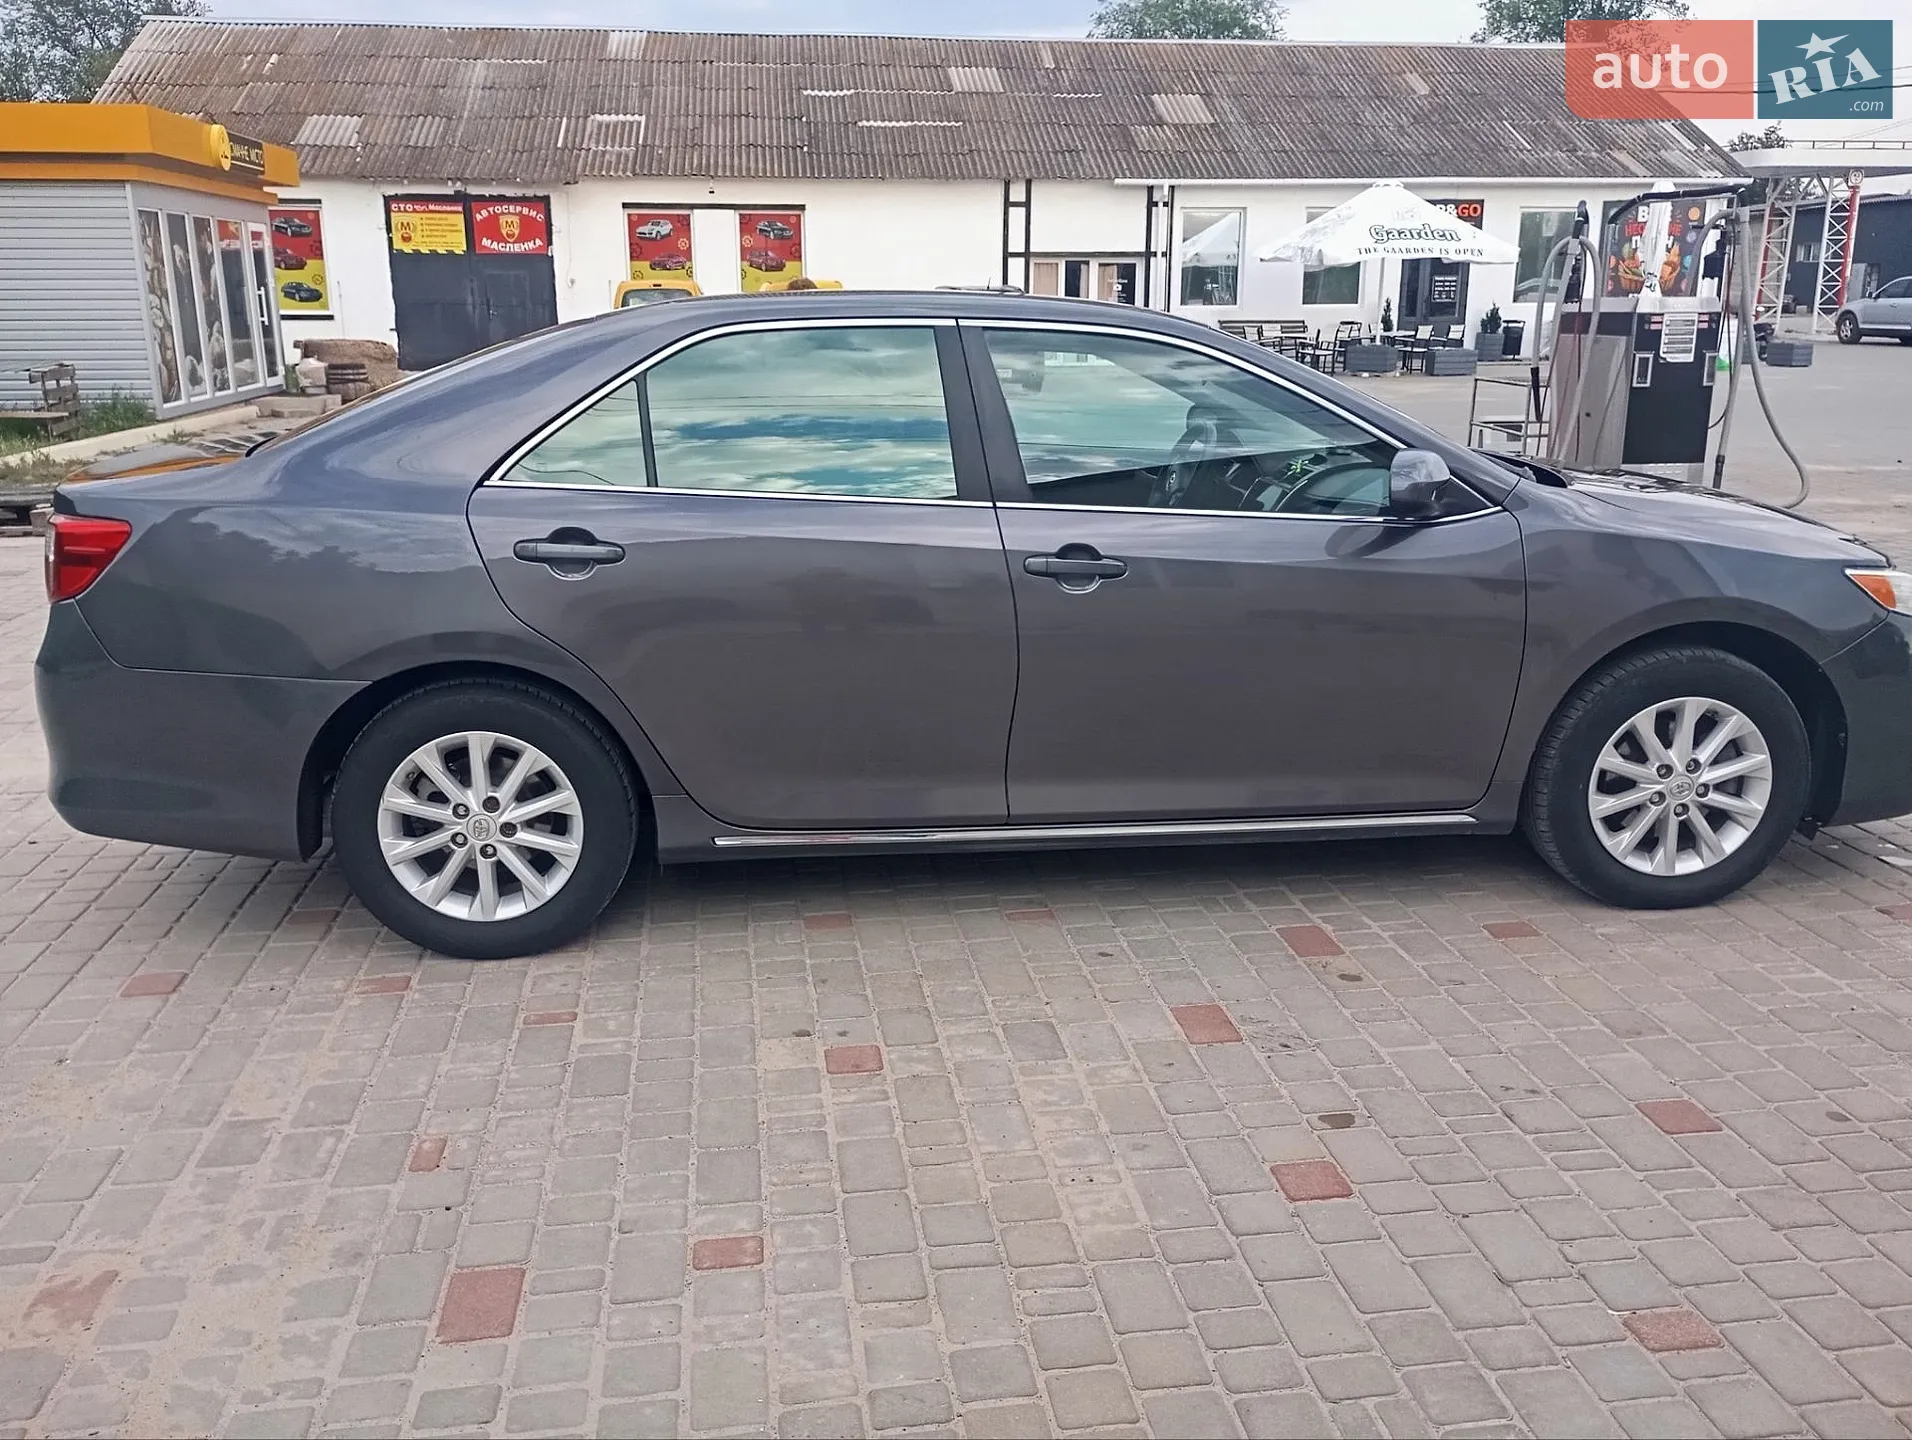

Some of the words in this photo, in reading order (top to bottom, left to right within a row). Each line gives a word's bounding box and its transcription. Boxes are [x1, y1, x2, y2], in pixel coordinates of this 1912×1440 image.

[391, 203, 413, 211] СТО
[475, 204, 545, 222] АВТОСЕРВИС
[1369, 223, 1461, 244] Gaarden
[481, 236, 544, 252] МАСЛЕНКА
[1357, 247, 1380, 255] THE
[1383, 246, 1434, 254] GAARDEN
[1439, 247, 1450, 255] IS
[1454, 247, 1484, 257] OPEN
